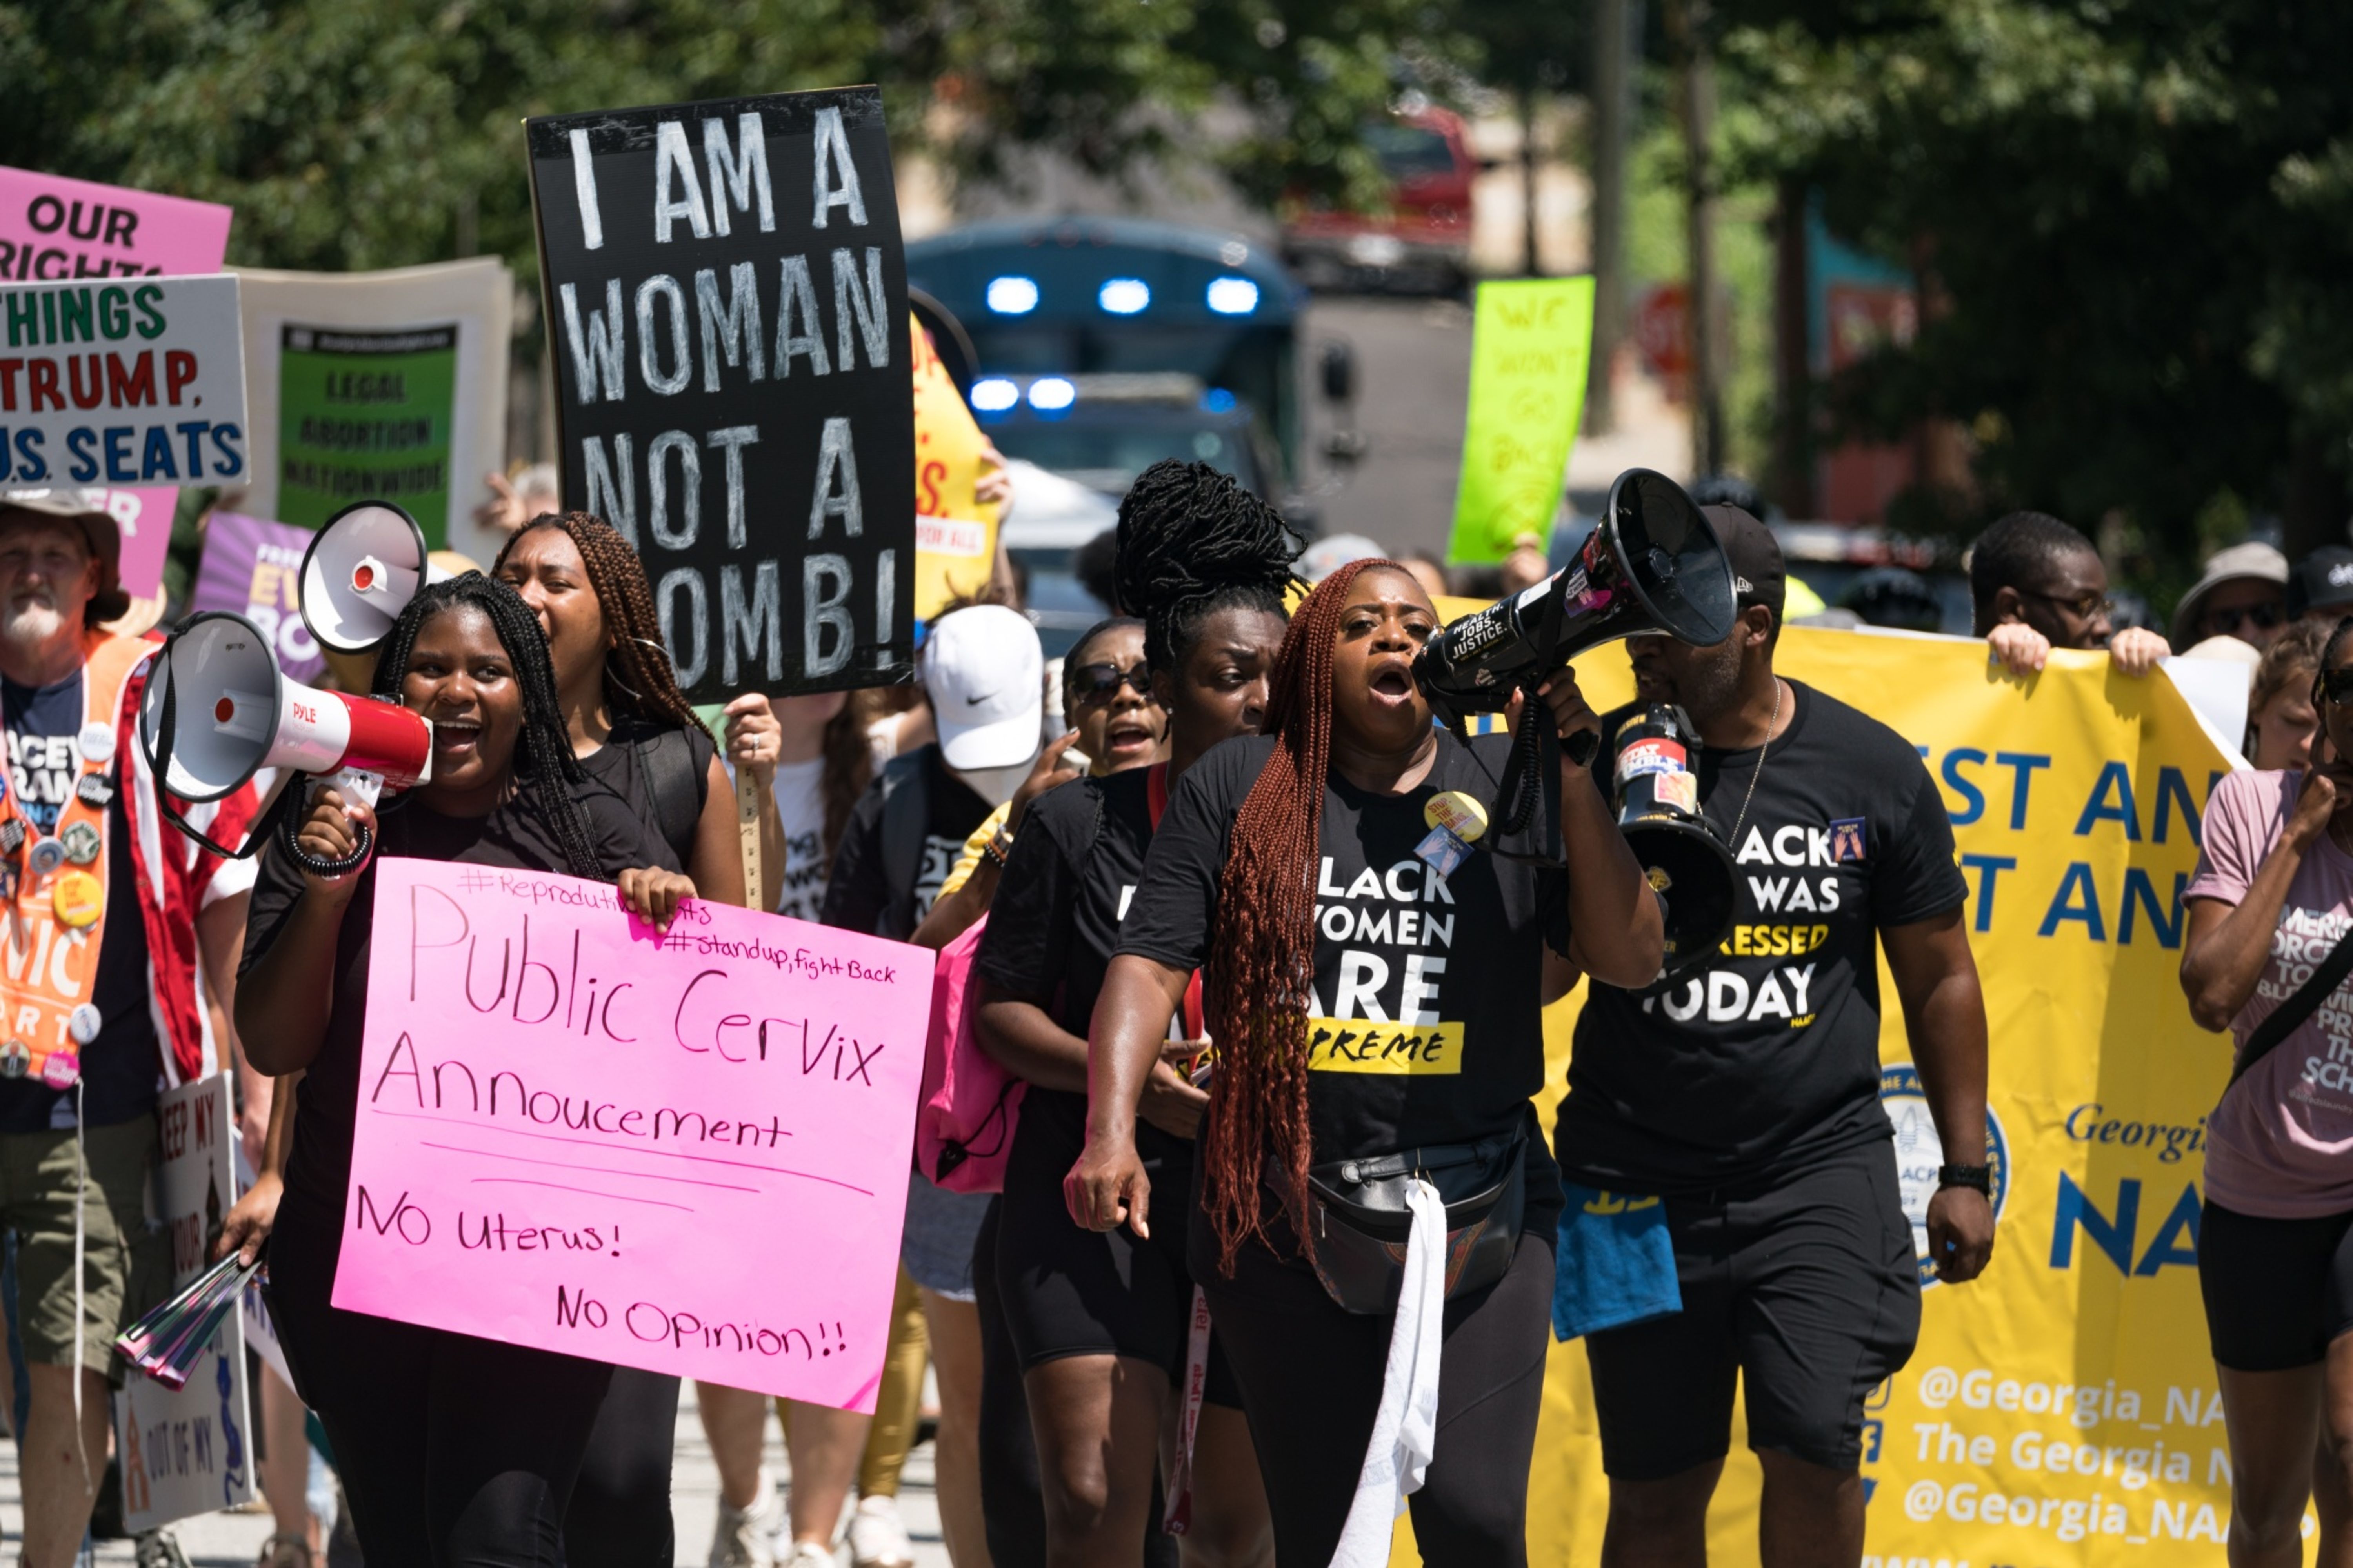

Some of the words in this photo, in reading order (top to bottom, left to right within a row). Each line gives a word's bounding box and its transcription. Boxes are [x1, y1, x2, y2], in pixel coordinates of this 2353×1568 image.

[569, 129, 603, 250] I
[655, 112, 776, 243] AM
[812, 106, 868, 229] A
[27, 194, 138, 249] OUR
[0, 285, 166, 347] HINGS
[560, 246, 889, 404] WOMAN
[326, 371, 406, 404] LEGAL
[66, 421, 242, 482] SEATS
[582, 424, 762, 550] NOT
[808, 416, 863, 540] A
[657, 549, 896, 689] OMB!
[1453, 622, 1507, 659] JUSTICE.
[1454, 603, 1504, 634] HEALTH.
[1460, 617, 1495, 641] JOBS.
[1919, 746, 2052, 830] ST
[1734, 825, 1838, 868] ACK
[1318, 856, 1455, 904] LACK
[1747, 876, 1840, 914] WAS
[409, 885, 637, 1043] Public
[1308, 1028, 1446, 1062] PREME
[371, 1030, 793, 1147] Annoucement
[195, 1092, 214, 1152] MY
[147, 1421, 170, 1481] OUT
[193, 1415, 213, 1474] MY
[1913, 1423, 1996, 1467] The
[2011, 1430, 2191, 1491] Georgia
